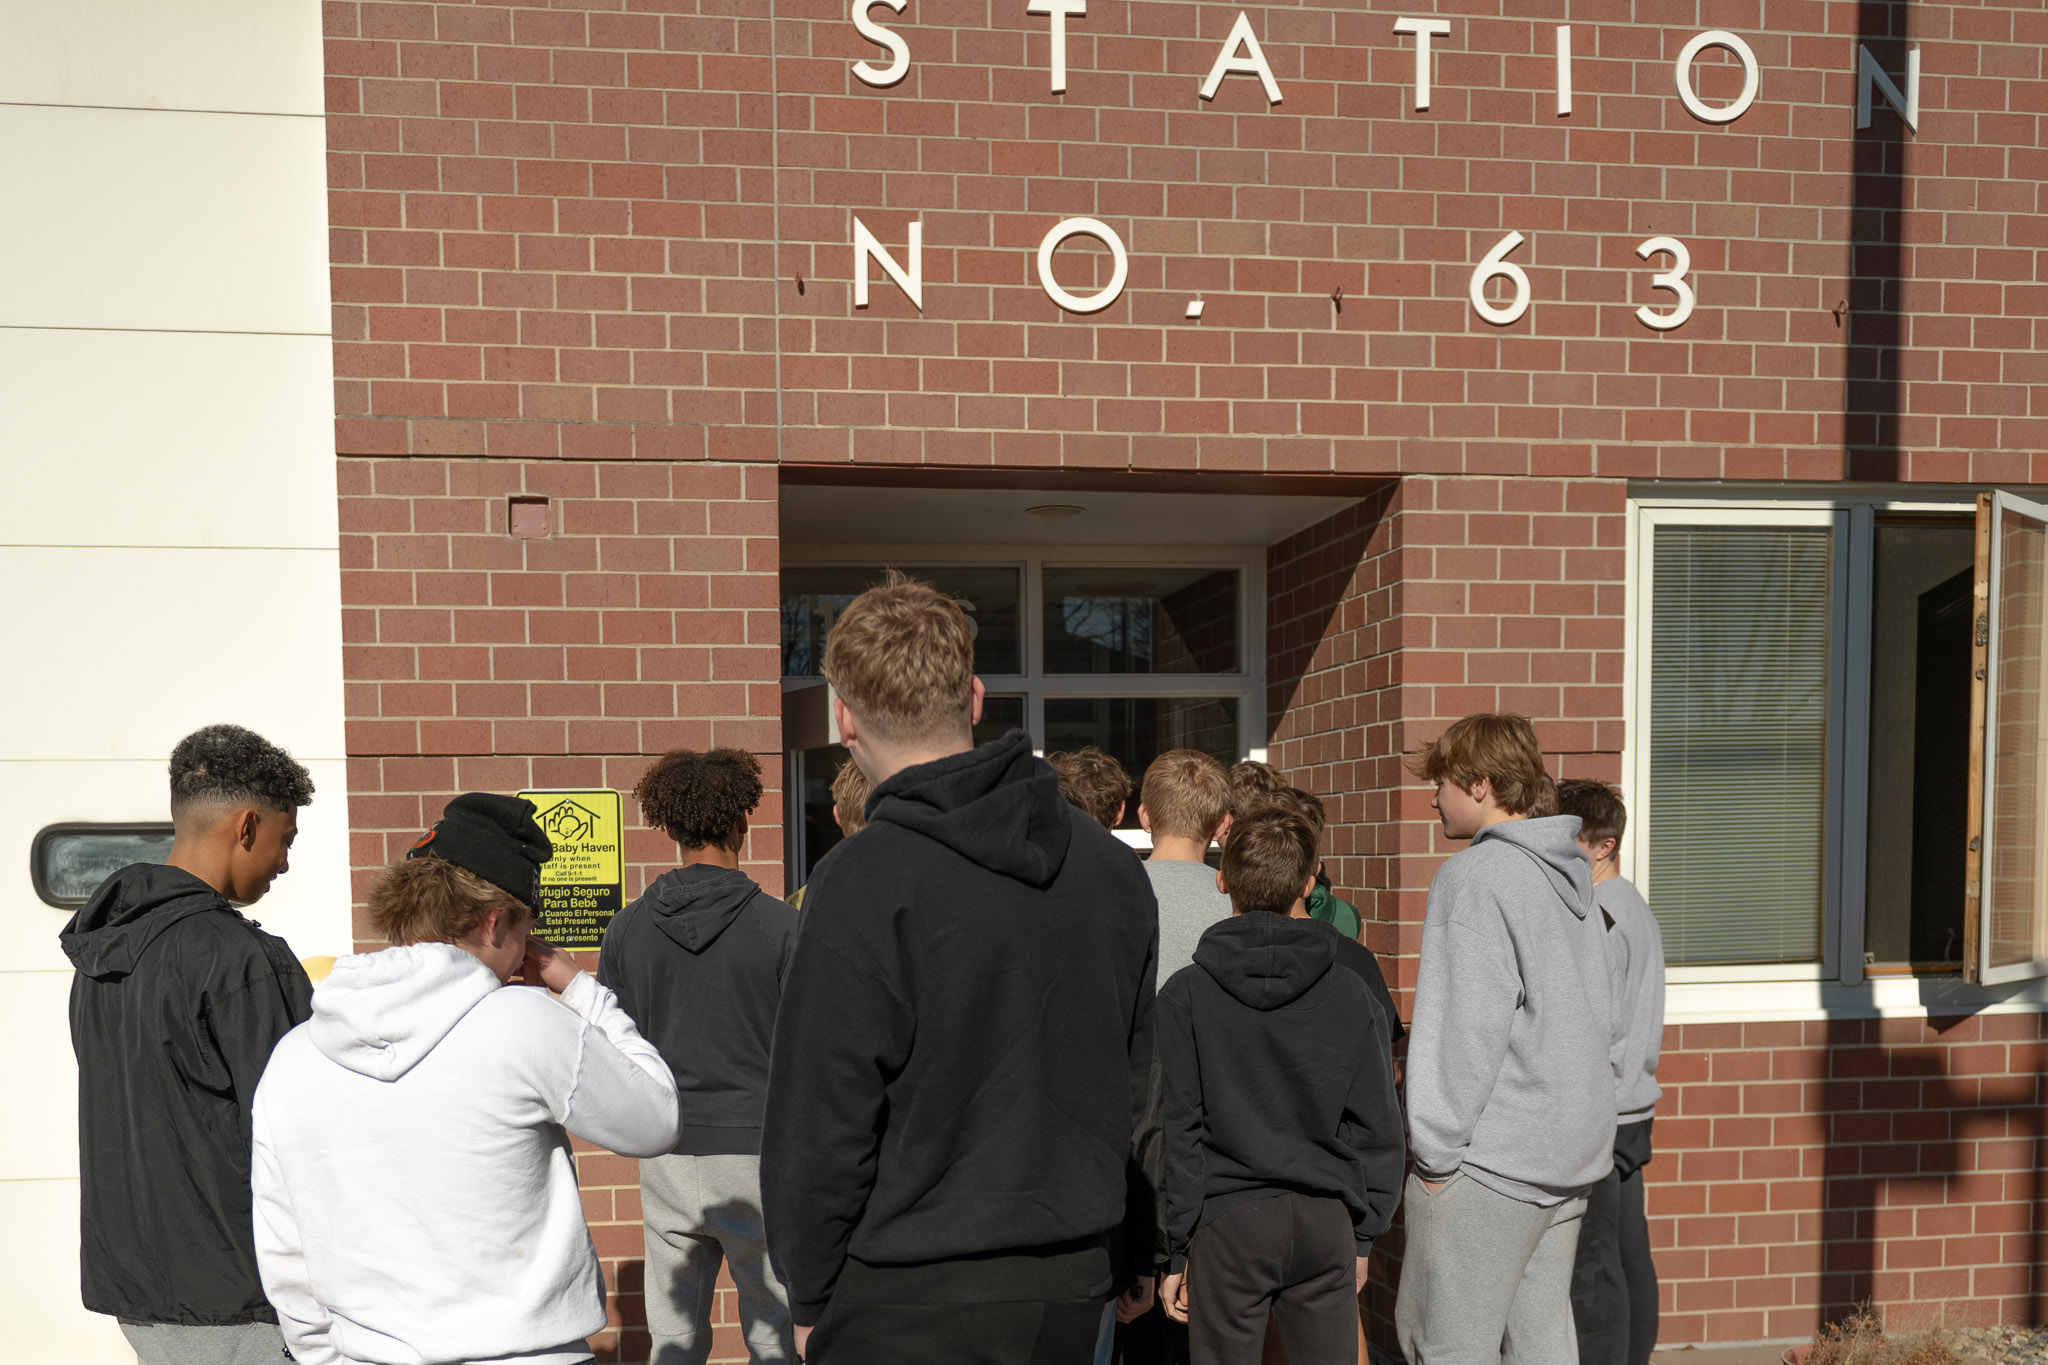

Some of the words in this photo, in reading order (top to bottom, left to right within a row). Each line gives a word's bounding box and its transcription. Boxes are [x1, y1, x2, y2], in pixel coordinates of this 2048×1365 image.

[851, 0, 1921, 135] STATION
[854, 216, 1204, 318] NO.
[1469, 230, 1696, 330] 63
[552, 842, 578, 855] Baby
[581, 842, 616, 853] Haven
[569, 862, 601, 870] present
[575, 875, 598, 883] present
[539, 886, 571, 899] efugio
[572, 886, 610, 899] Seguro
[543, 898, 568, 908] Para
[570, 897, 598, 908] Bebé
[544, 909, 574, 917] Cuando
[574, 909, 582, 917] El
[583, 908, 615, 917] Personal
[546, 917, 563, 925] Esté
[563, 917, 597, 925] Presente
[581, 926, 588, 934] si
[544, 934, 566, 942] nadie
